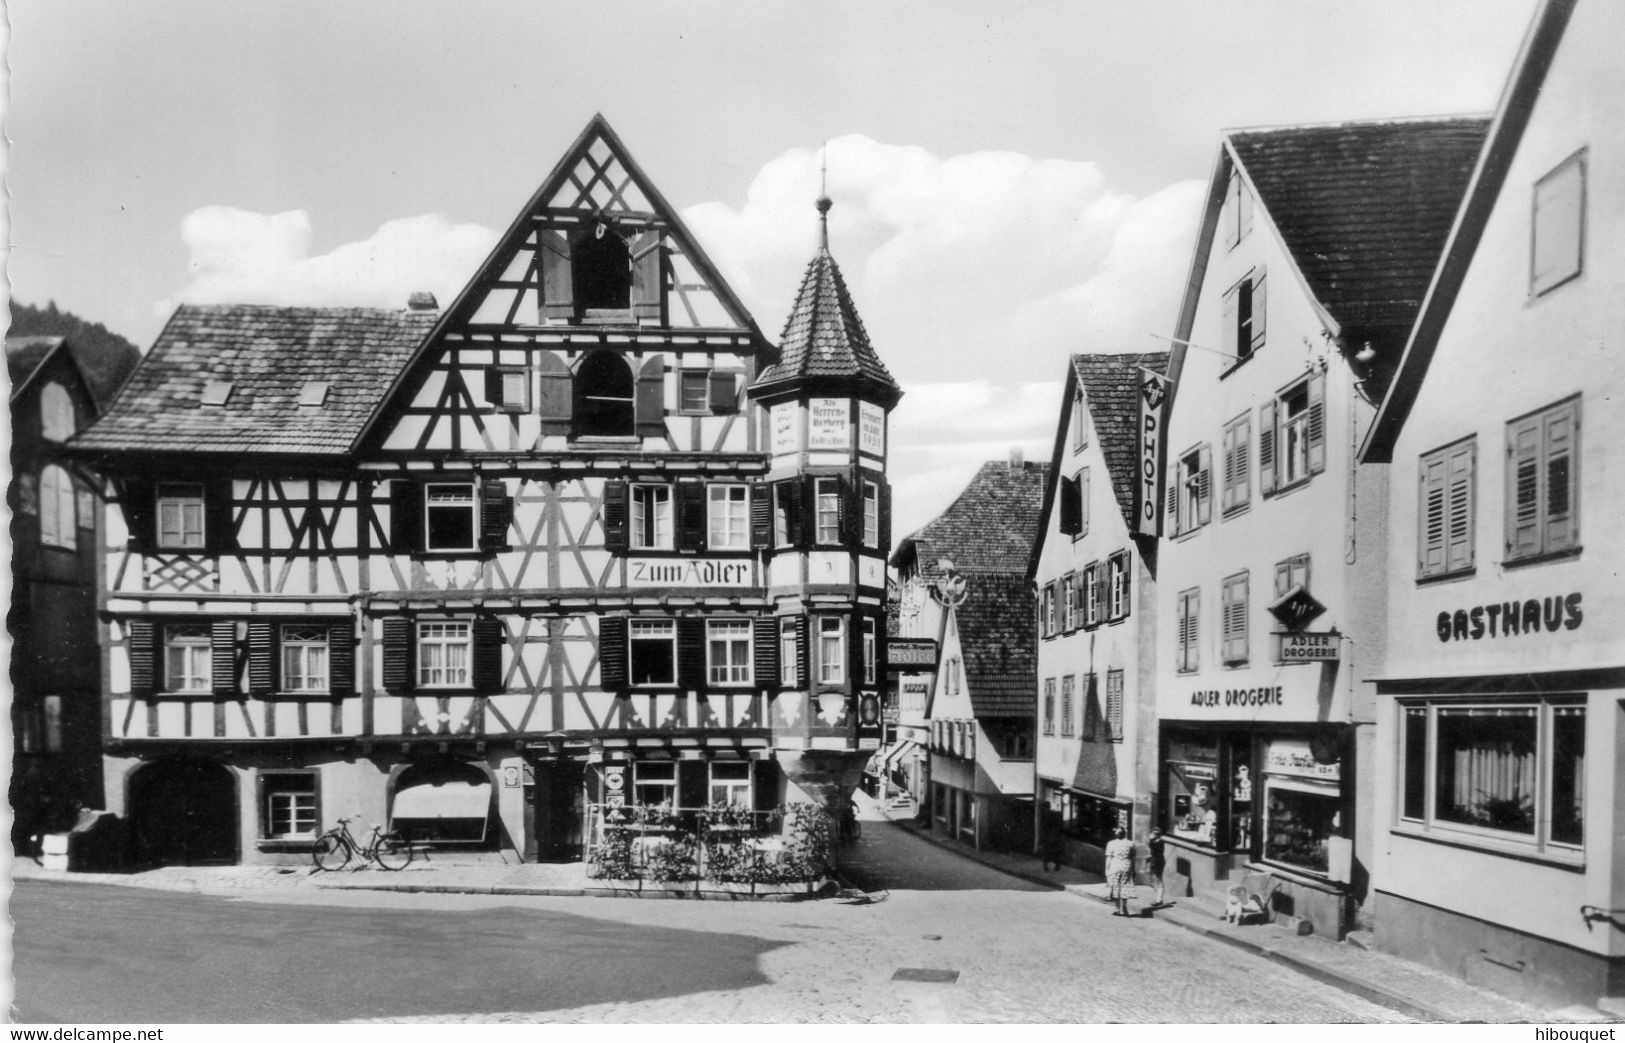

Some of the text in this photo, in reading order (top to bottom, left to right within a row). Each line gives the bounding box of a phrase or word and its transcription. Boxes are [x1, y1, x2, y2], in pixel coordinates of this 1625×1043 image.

[1143, 414, 1157, 521] PHOTO
[632, 560, 747, 583] Zum Adler
[1437, 592, 1583, 643] GASTHAUS
[1284, 648, 1337, 657] DROGERIE
[1291, 637, 1329, 646] ADLER
[1191, 686, 1282, 707] ADLER DROGERIE
